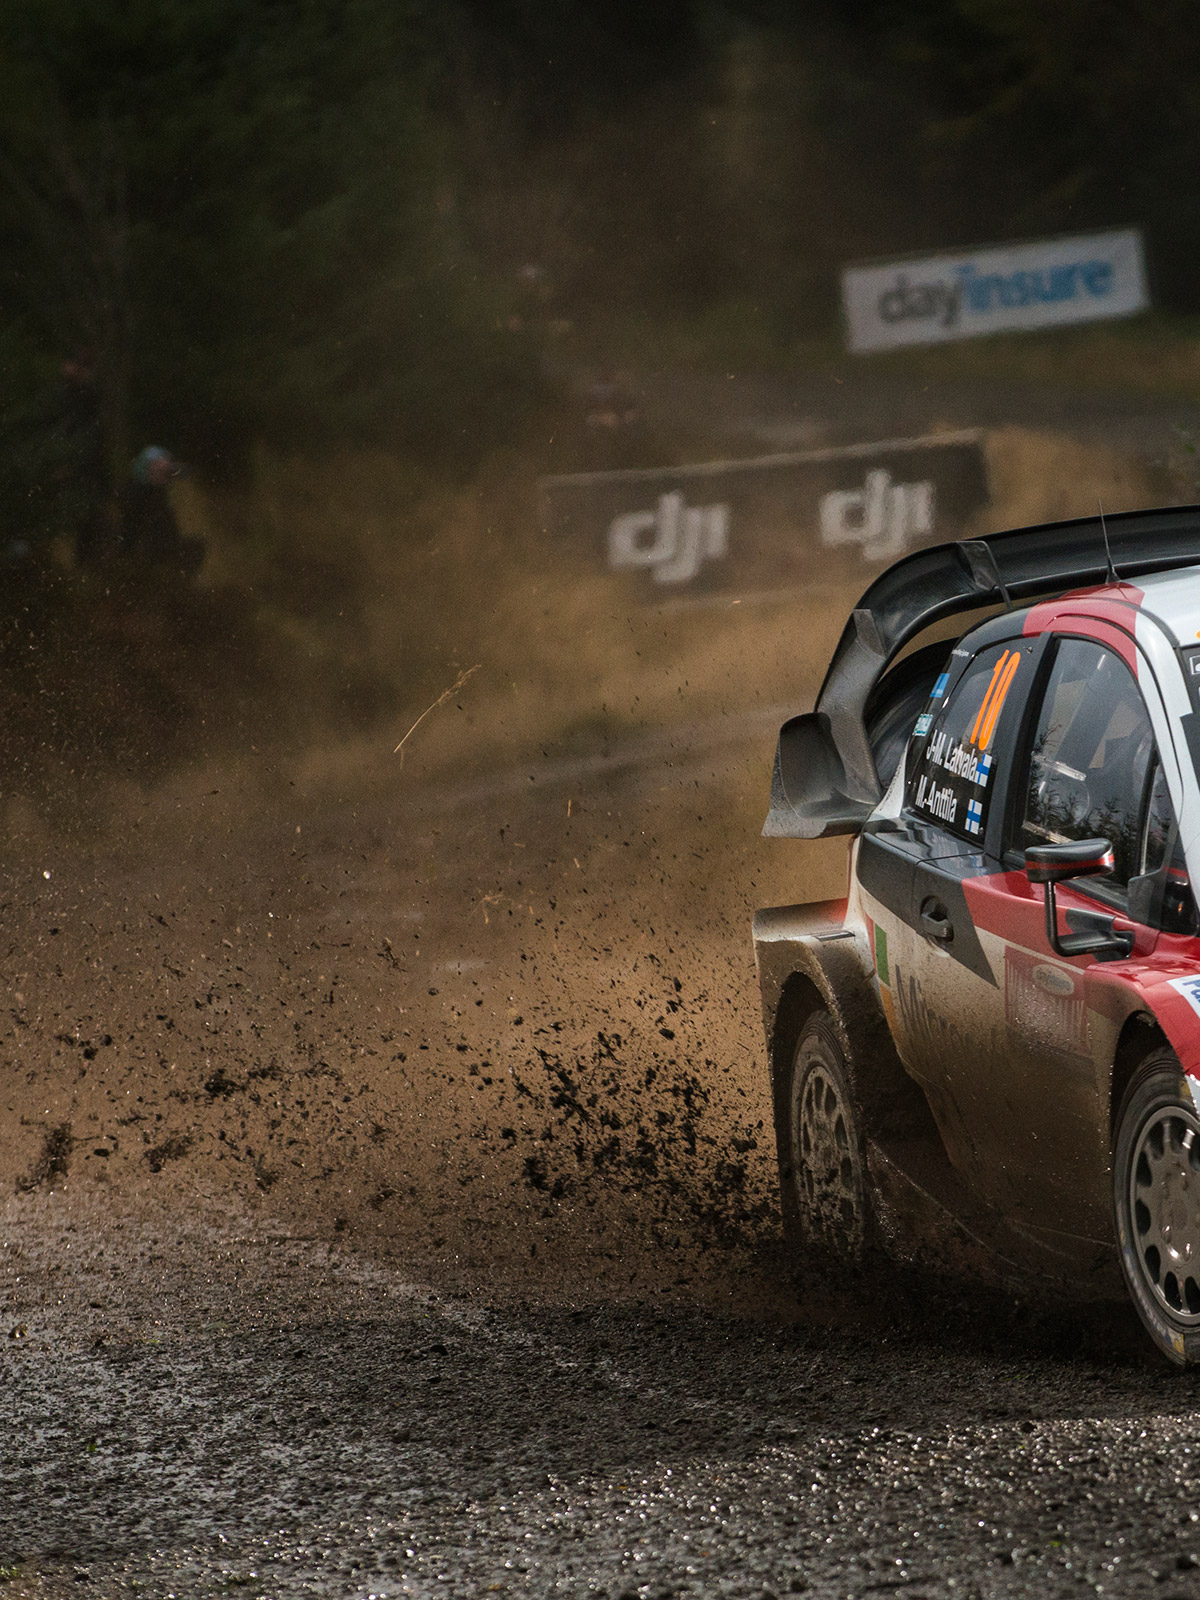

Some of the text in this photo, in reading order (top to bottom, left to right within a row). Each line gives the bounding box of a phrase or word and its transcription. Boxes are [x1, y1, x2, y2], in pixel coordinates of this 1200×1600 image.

[879, 261, 1111, 327] dayinsure
[970, 649, 1021, 750] 10
[943, 737, 978, 781] Latvala
[926, 781, 957, 823] Anttila
